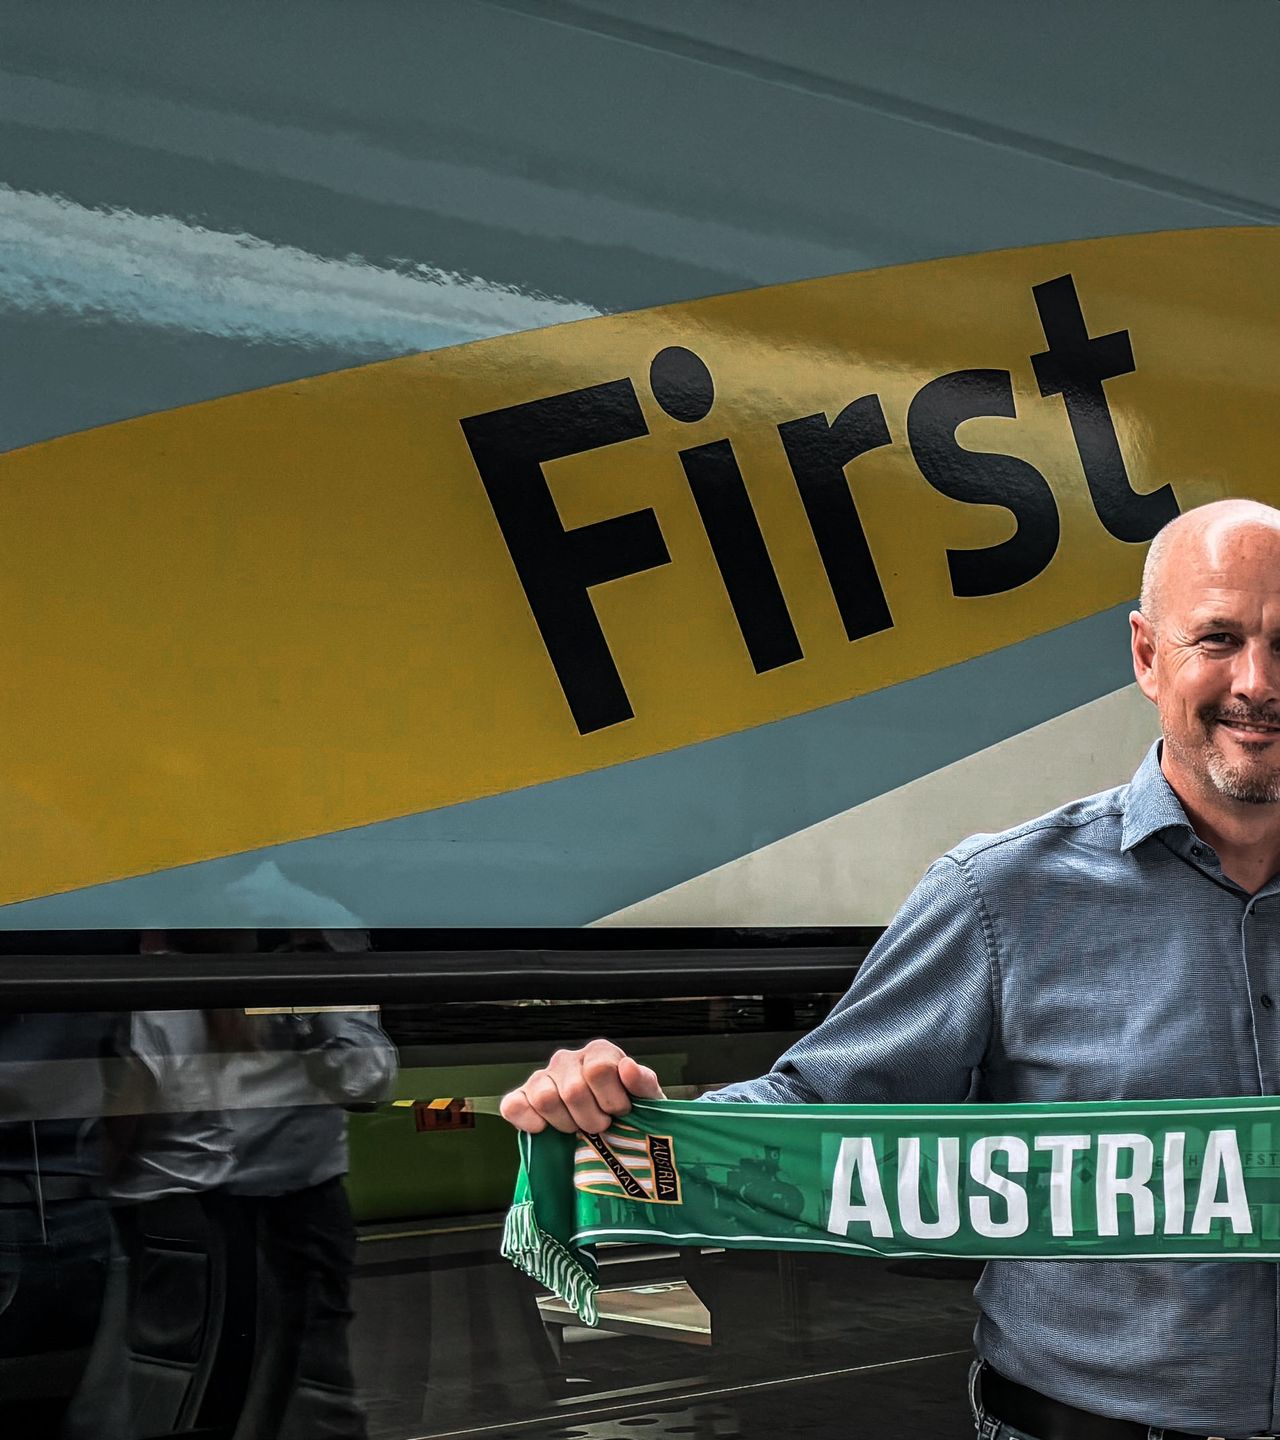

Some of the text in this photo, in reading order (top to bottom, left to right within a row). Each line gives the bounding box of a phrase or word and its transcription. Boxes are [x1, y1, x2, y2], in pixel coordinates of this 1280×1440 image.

[459, 273, 1181, 736] First
[652, 1139, 675, 1196] AUSTRIA
[827, 1129, 1254, 1239] AUSTRIA
